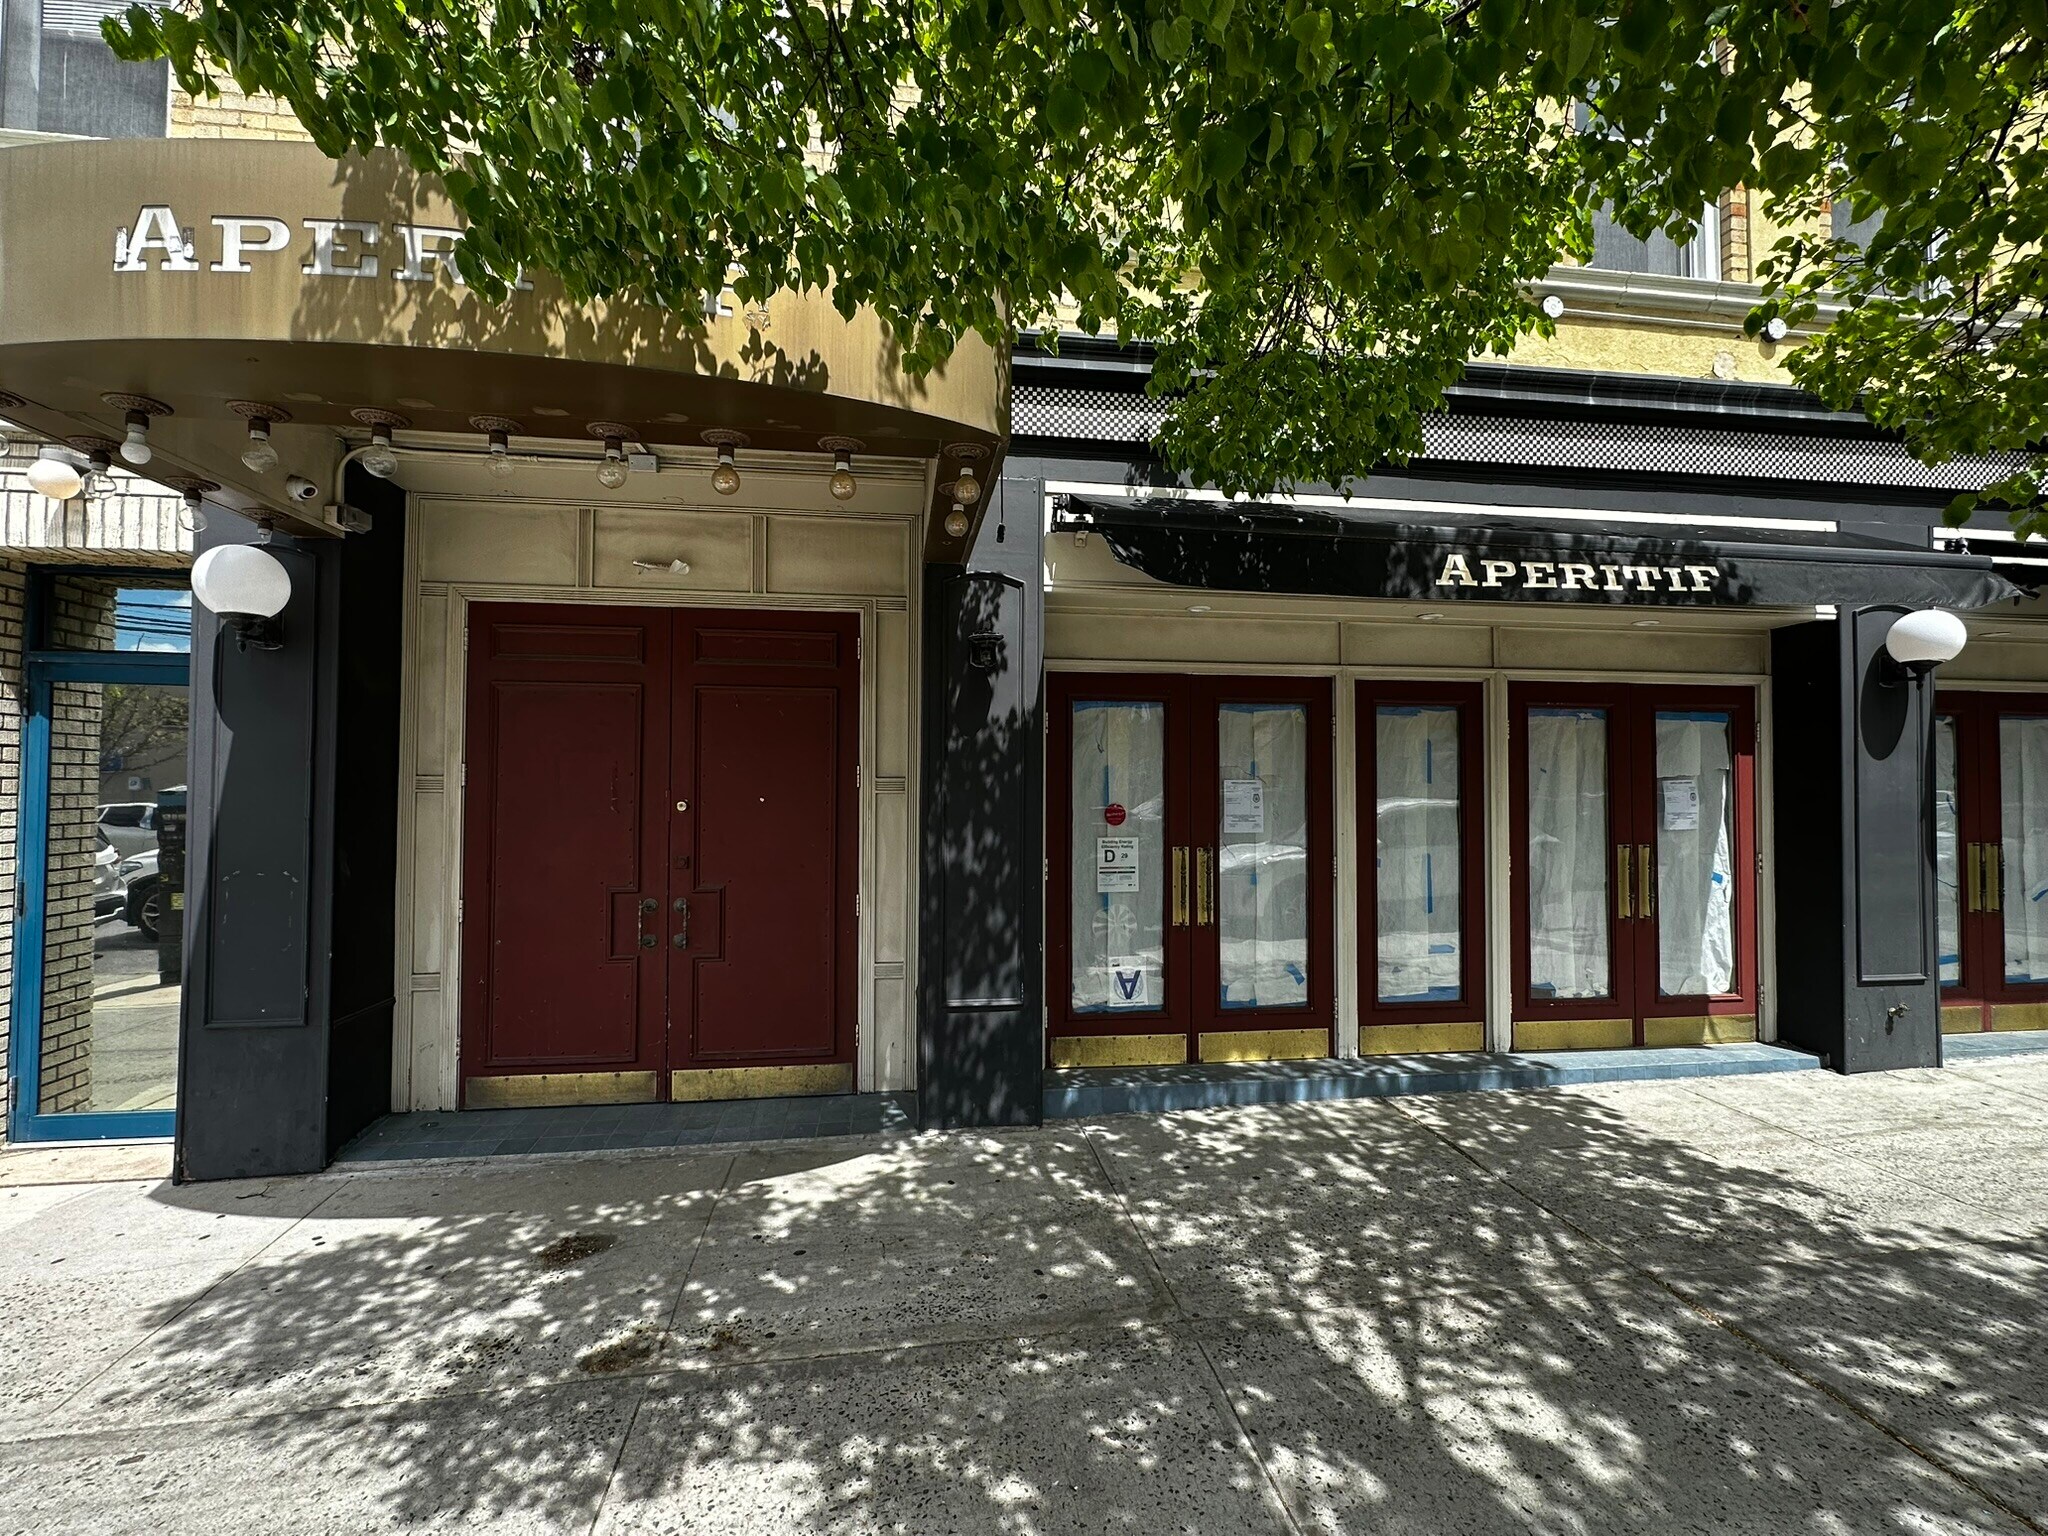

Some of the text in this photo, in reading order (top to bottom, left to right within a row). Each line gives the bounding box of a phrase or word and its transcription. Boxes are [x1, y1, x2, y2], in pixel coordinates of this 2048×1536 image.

[1435, 554, 1720, 592] APERITIF
[1105, 850, 1115, 862] D
[1116, 970, 1141, 999] A
